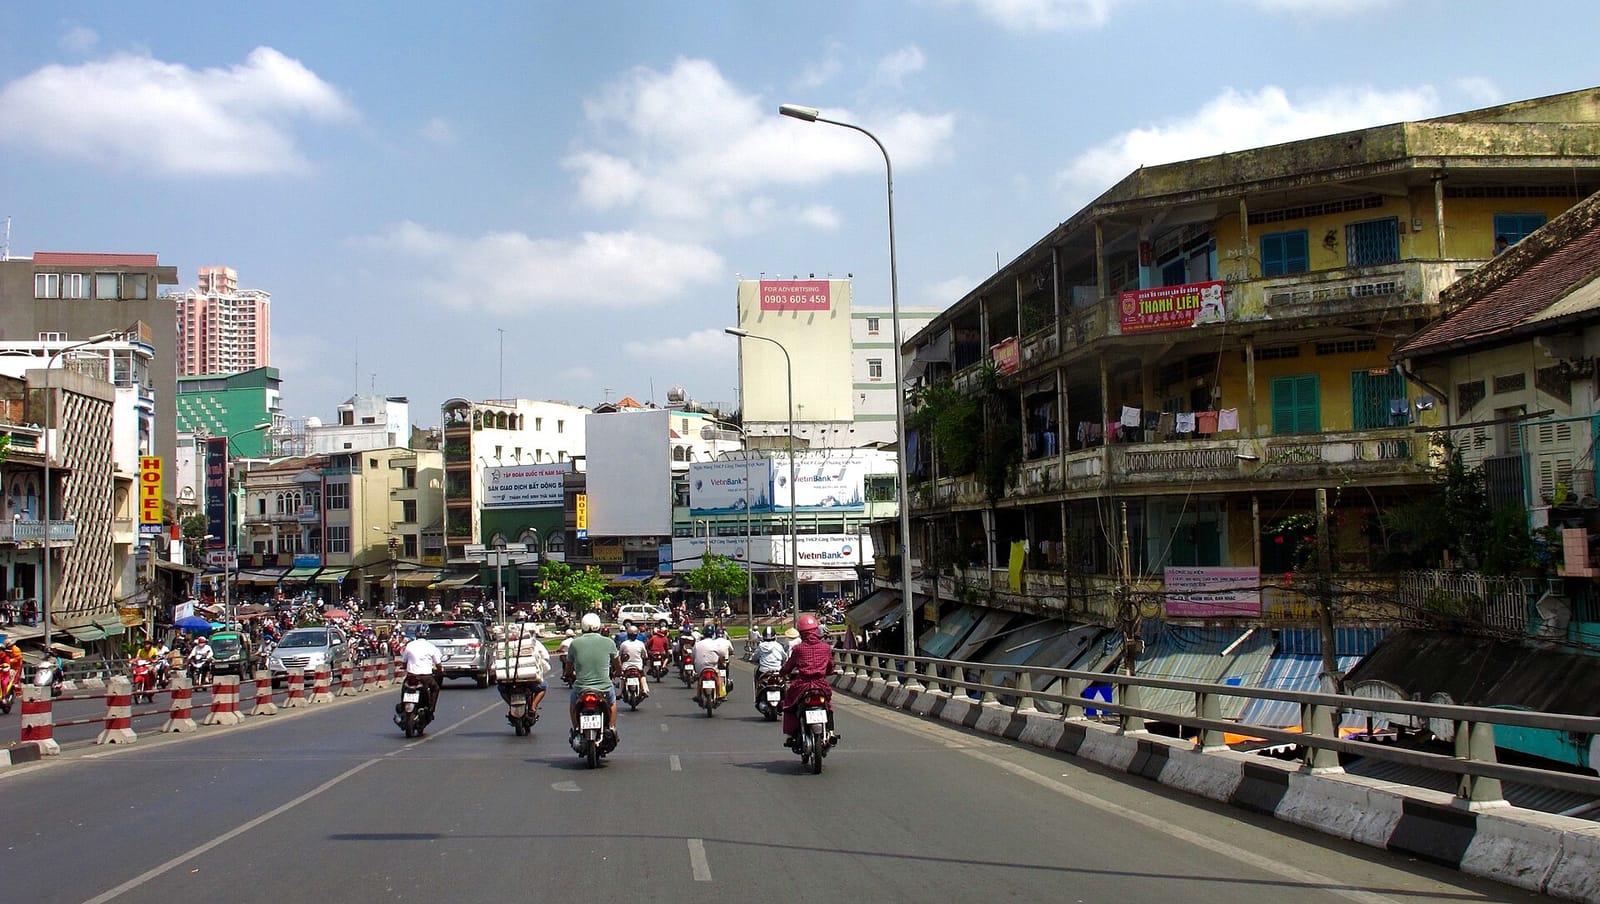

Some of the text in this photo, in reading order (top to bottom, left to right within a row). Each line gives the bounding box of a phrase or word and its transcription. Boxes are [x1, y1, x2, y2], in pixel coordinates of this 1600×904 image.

[764, 295, 826, 303] 0903 605 459
[1139, 294, 1199, 314] THANH LIÊN
[710, 478, 742, 486] VietinBank
[143, 459, 160, 520] HOTEL
[798, 551, 842, 560] VietinBank
